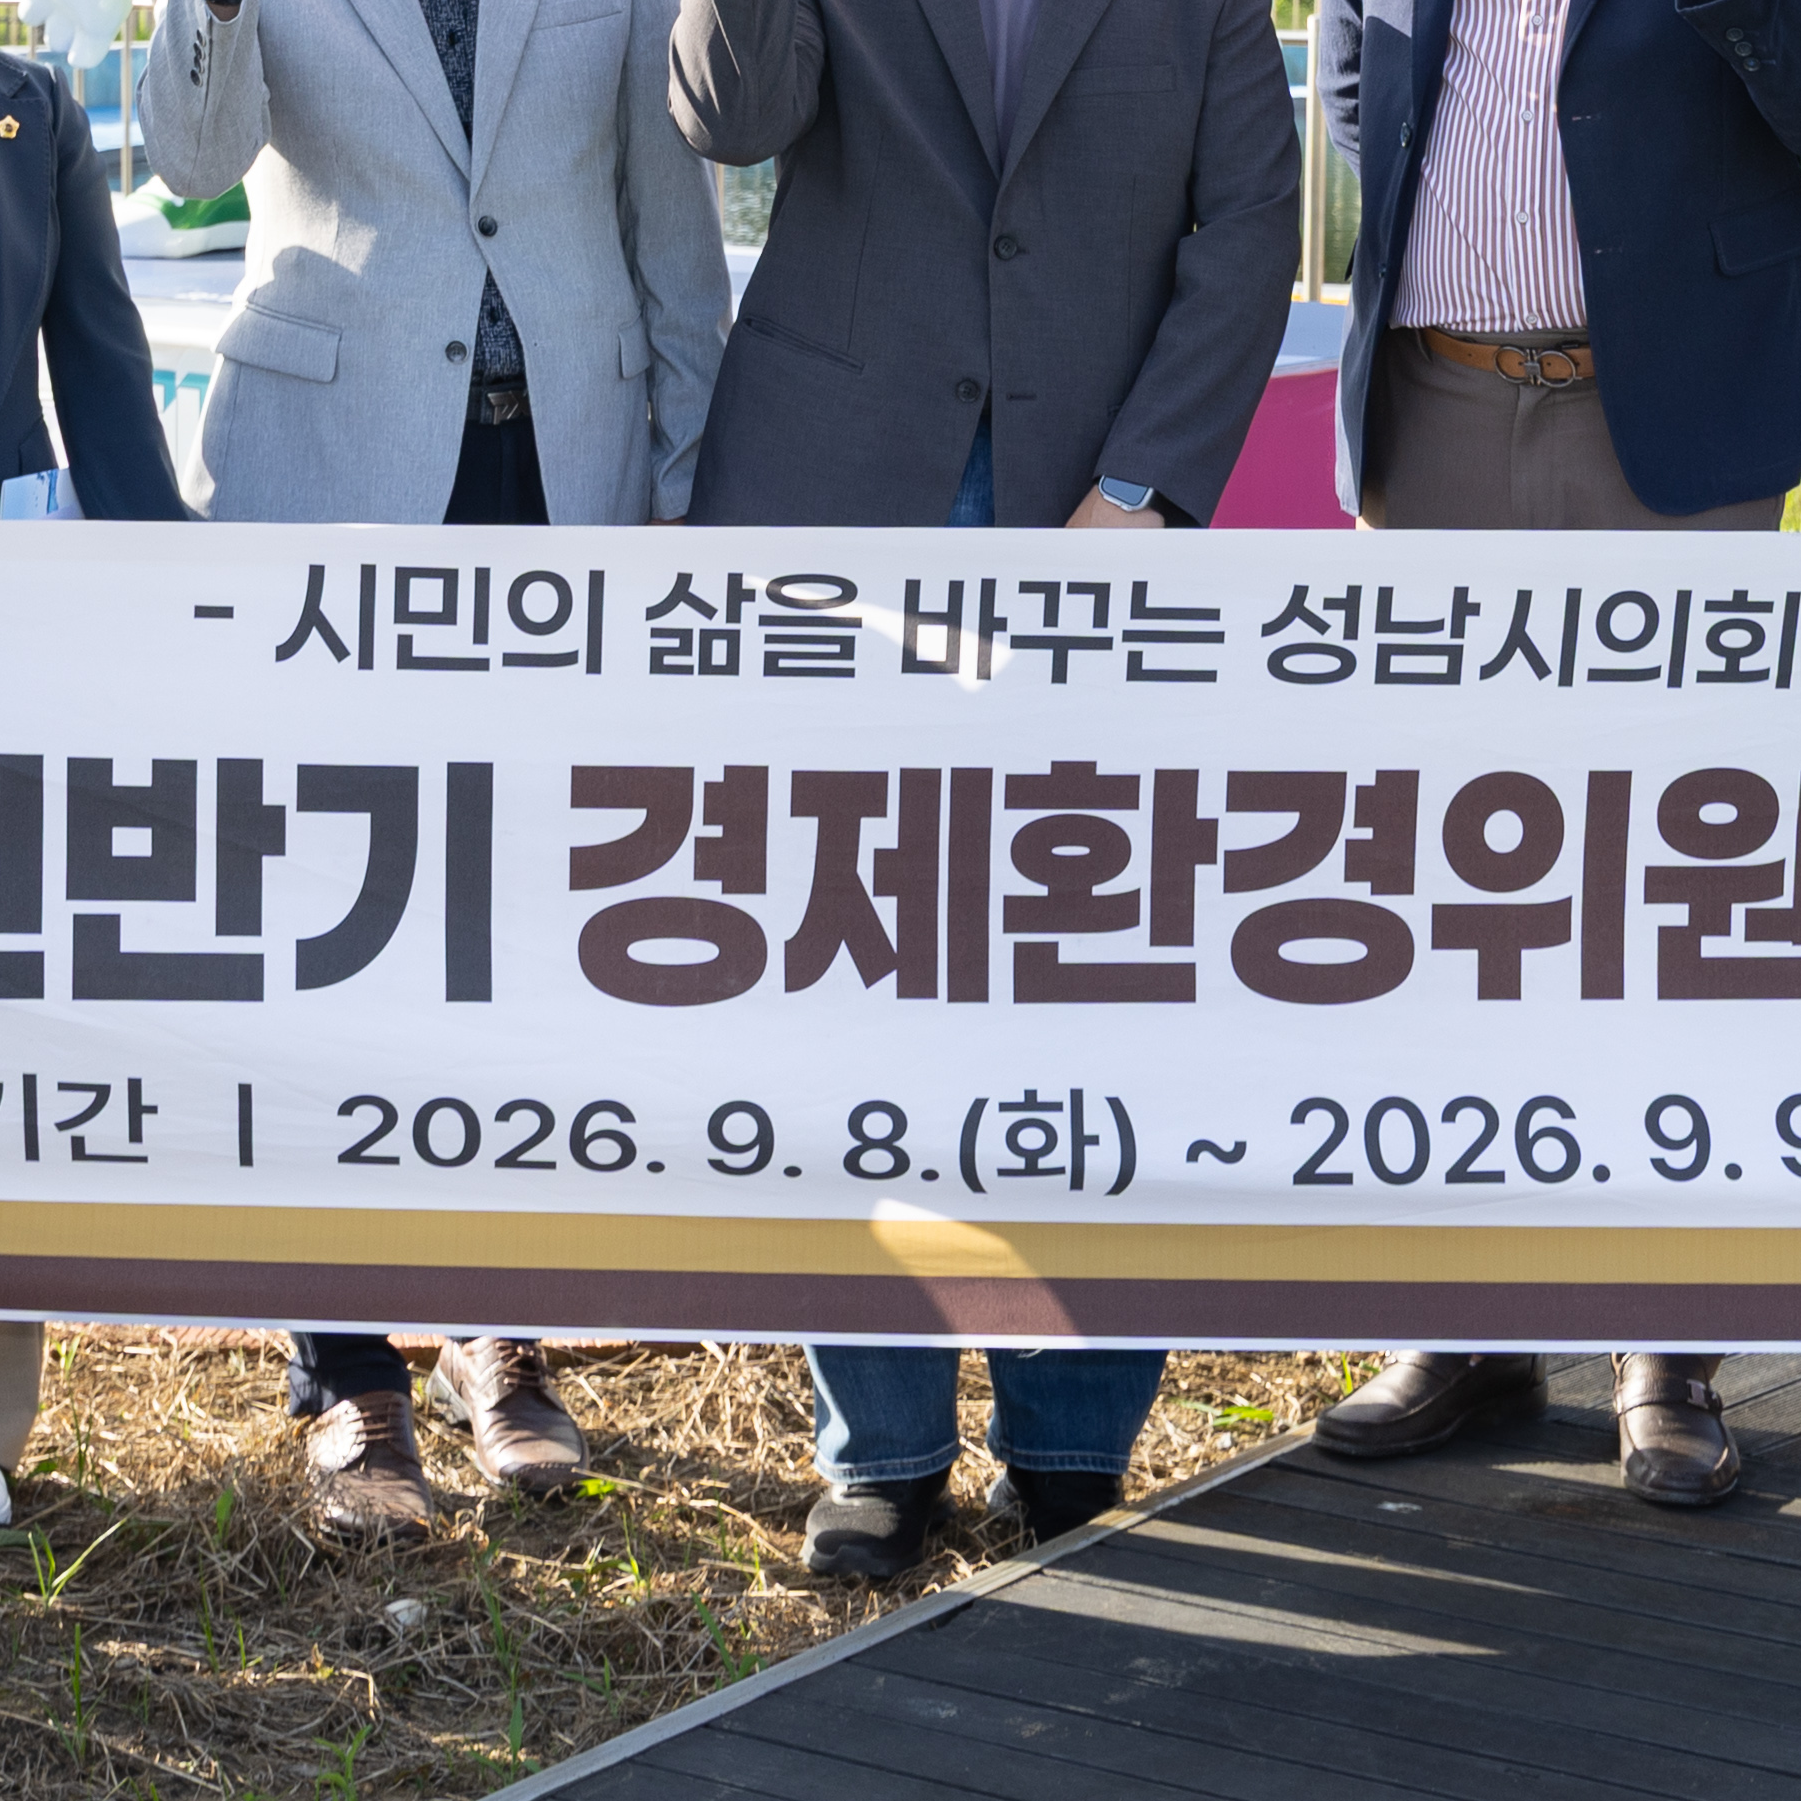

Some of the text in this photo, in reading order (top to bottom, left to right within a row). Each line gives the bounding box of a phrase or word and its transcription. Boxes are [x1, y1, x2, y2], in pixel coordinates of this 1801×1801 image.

[275, 564, 605, 675] 시민의
[645, 570, 862, 679] 삶을
[901, 578, 1225, 685] 바꾸는
[1261, 584, 1801, 689] 성남시의회
[337, 1095, 665, 1175] 2026.
[707, 1100, 802, 1179] 9.
[843, 1088, 1136, 1197] 8.(화)
[1290, 1095, 1610, 1187] 2026.
[1644, 1094, 1742, 1183] 9.
